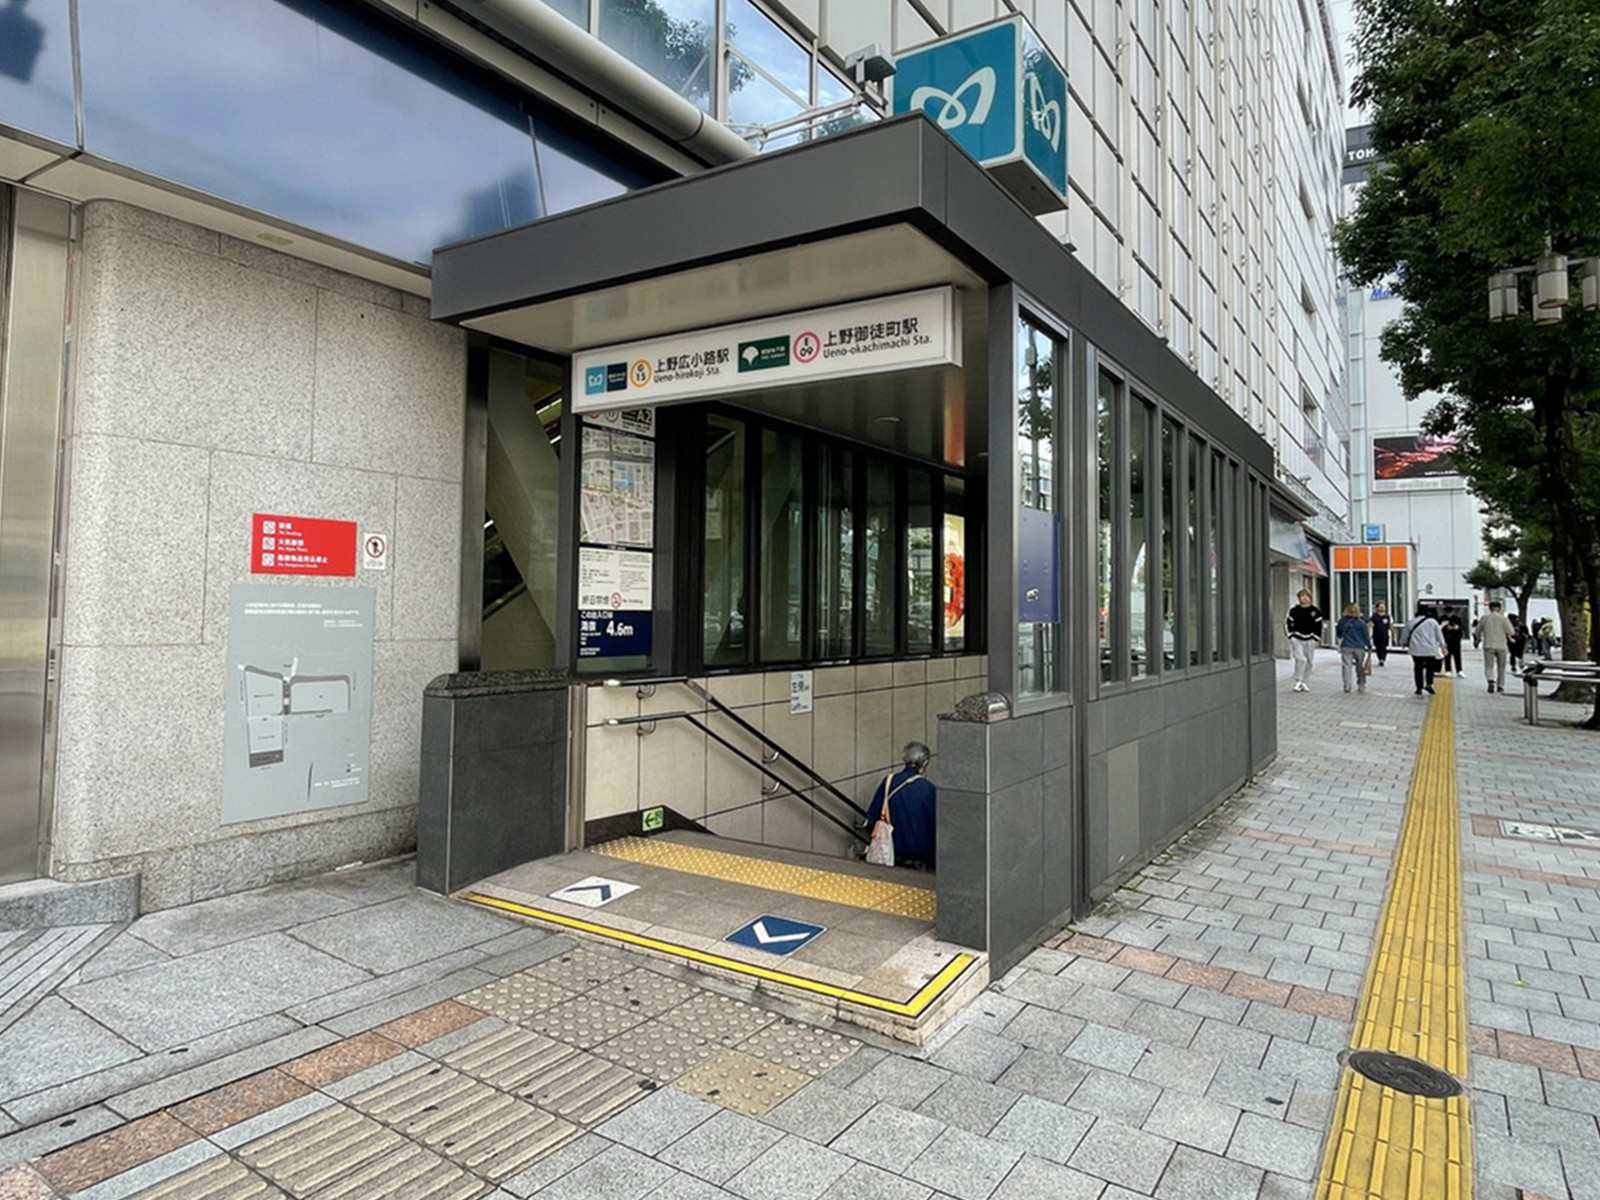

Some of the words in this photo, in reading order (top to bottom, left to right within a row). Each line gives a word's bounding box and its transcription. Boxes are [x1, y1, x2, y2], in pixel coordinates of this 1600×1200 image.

[1347, 147, 1379, 161] TOH
[823, 317, 918, 347] 上野御徒町駅
[800, 347, 813, 358] 09
[823, 336, 911, 359] Ueno-okachimachi
[912, 335, 932, 346] Sta.
[637, 363, 645, 373] G
[654, 348, 730, 374] 上野広小路駅
[635, 373, 647, 383] 15
[653, 367, 705, 384] Ueno-hirokoji
[706, 366, 721, 377] Sta.
[637, 410, 652, 424] A2
[606, 620, 634, 637] 4.6m
